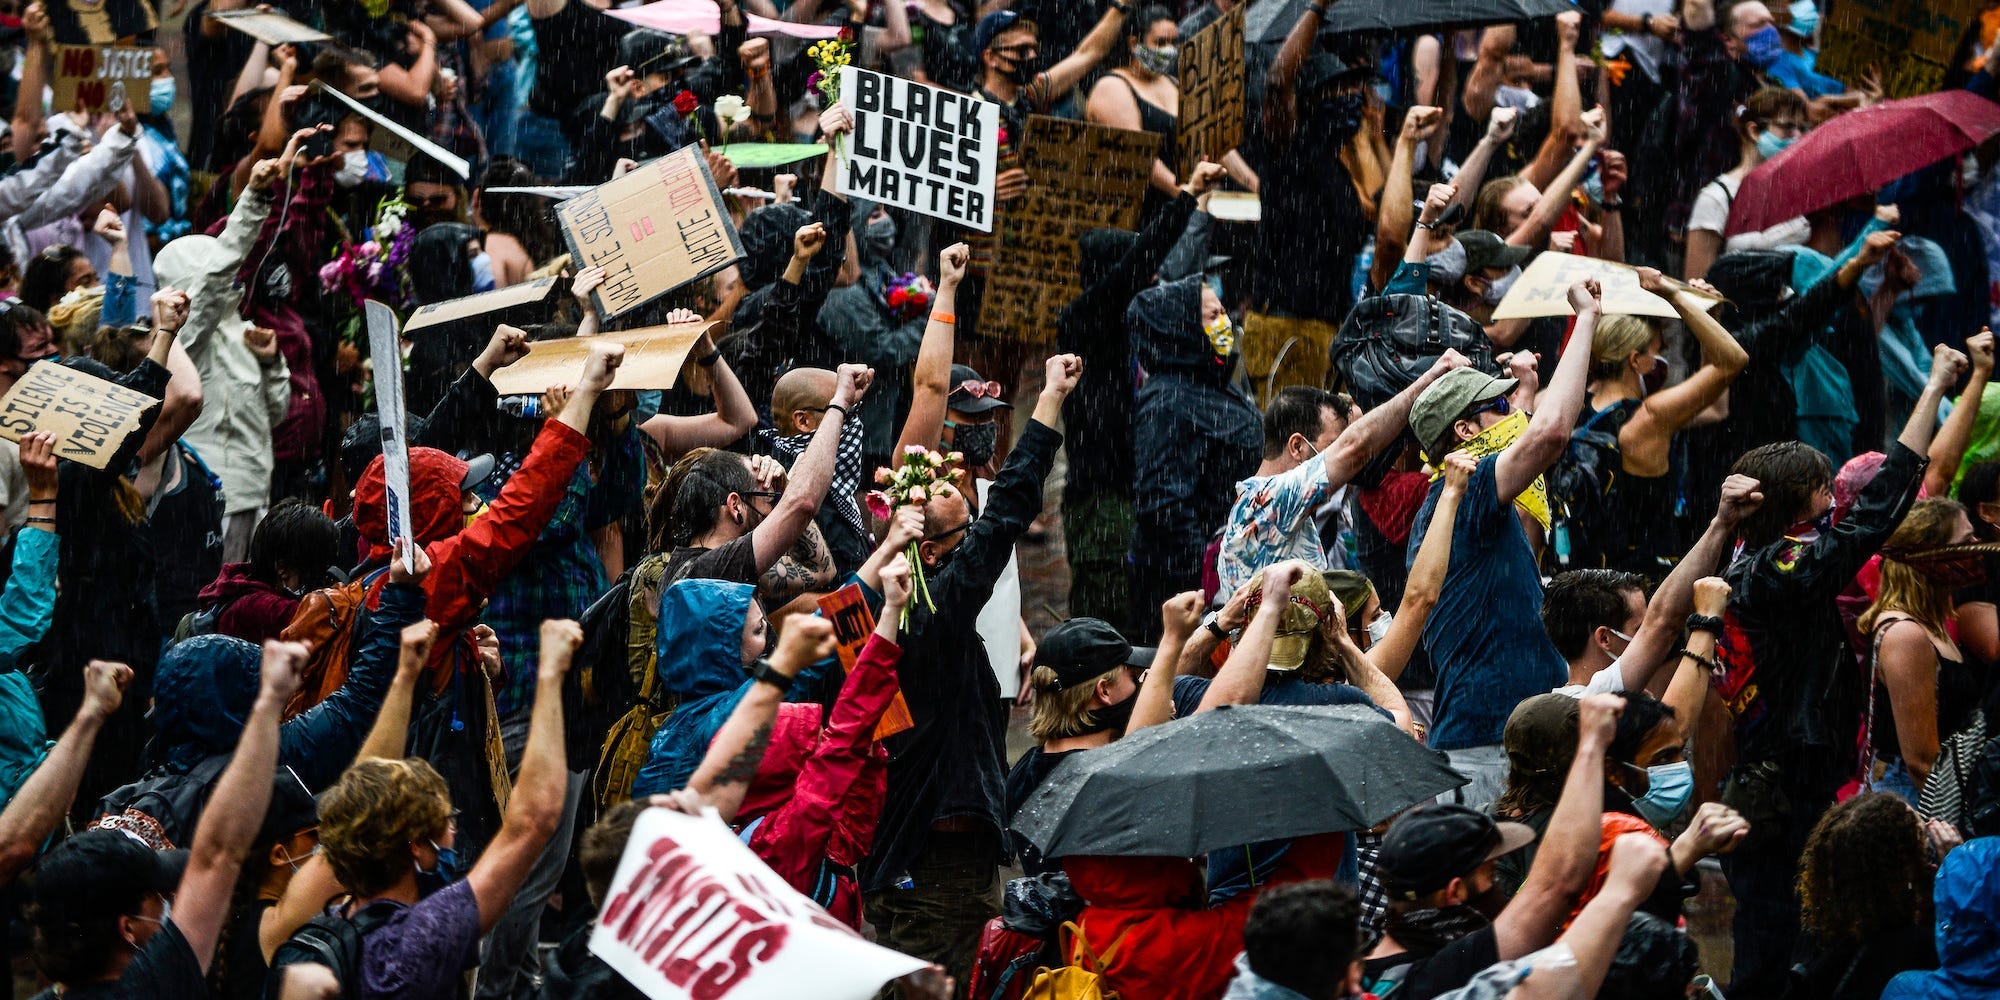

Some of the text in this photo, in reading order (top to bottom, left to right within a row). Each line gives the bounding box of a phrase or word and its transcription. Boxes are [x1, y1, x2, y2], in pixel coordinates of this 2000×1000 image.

[62, 48, 95, 78] NO
[1183, 2, 1243, 95] BLACK
[76, 80, 104, 112] NO
[855, 70, 982, 140] BLACK
[1181, 60, 1242, 134] LIVES
[853, 111, 981, 186] LIVES
[656, 151, 728, 275] WHITE VIOLENCE
[849, 159, 985, 224] MATTER
[591, 240, 641, 312] WHITE
[0, 369, 74, 434] SILENCE
[54, 397, 91, 418] IS
[62, 385, 148, 455] VIOLENCE
[602, 837, 788, 1000] SILENCE
